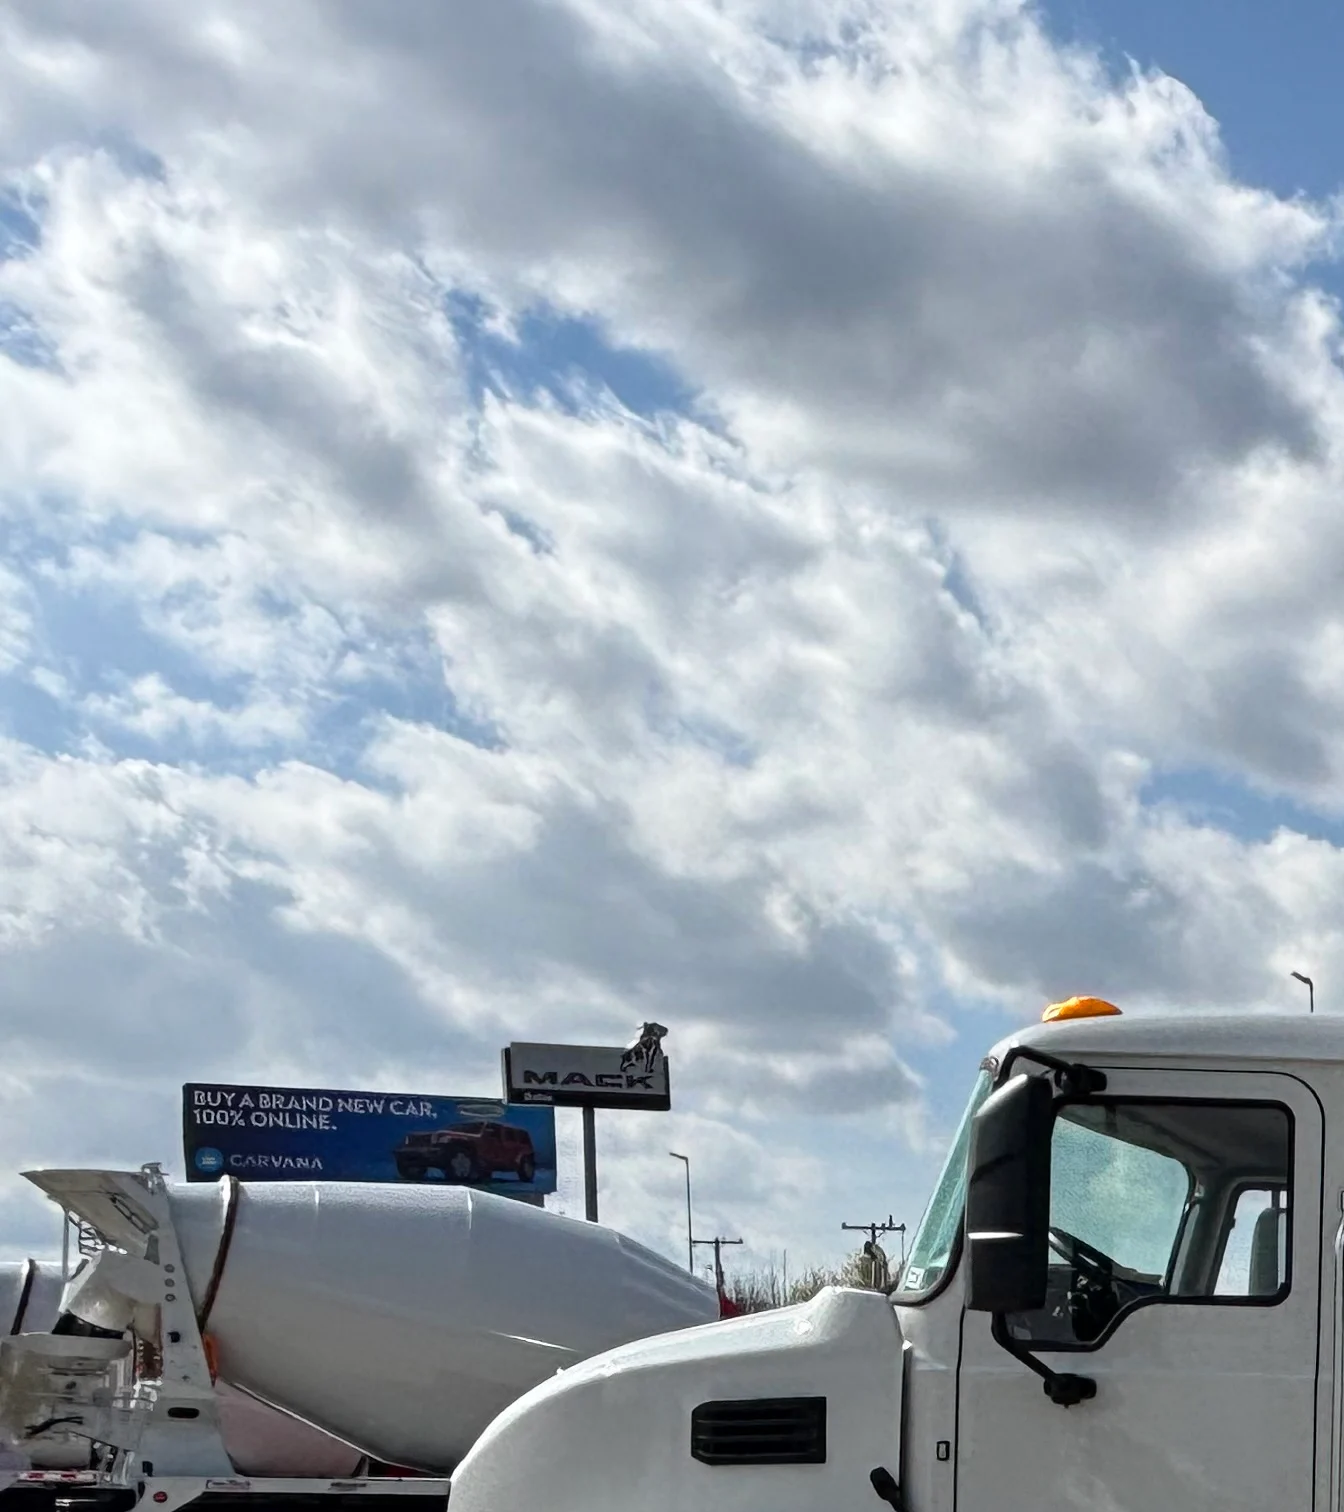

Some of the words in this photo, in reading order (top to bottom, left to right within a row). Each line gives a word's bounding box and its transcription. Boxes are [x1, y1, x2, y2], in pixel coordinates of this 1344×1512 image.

[523, 1069, 655, 1090] MACK
[193, 1090, 236, 1108] BUY
[240, 1092, 255, 1109] A
[259, 1093, 334, 1112] BRAND
[337, 1097, 385, 1114] NEW
[193, 1108, 246, 1127] 100%
[249, 1110, 338, 1131] ONLINE.
[229, 1153, 324, 1171] CARVANA
